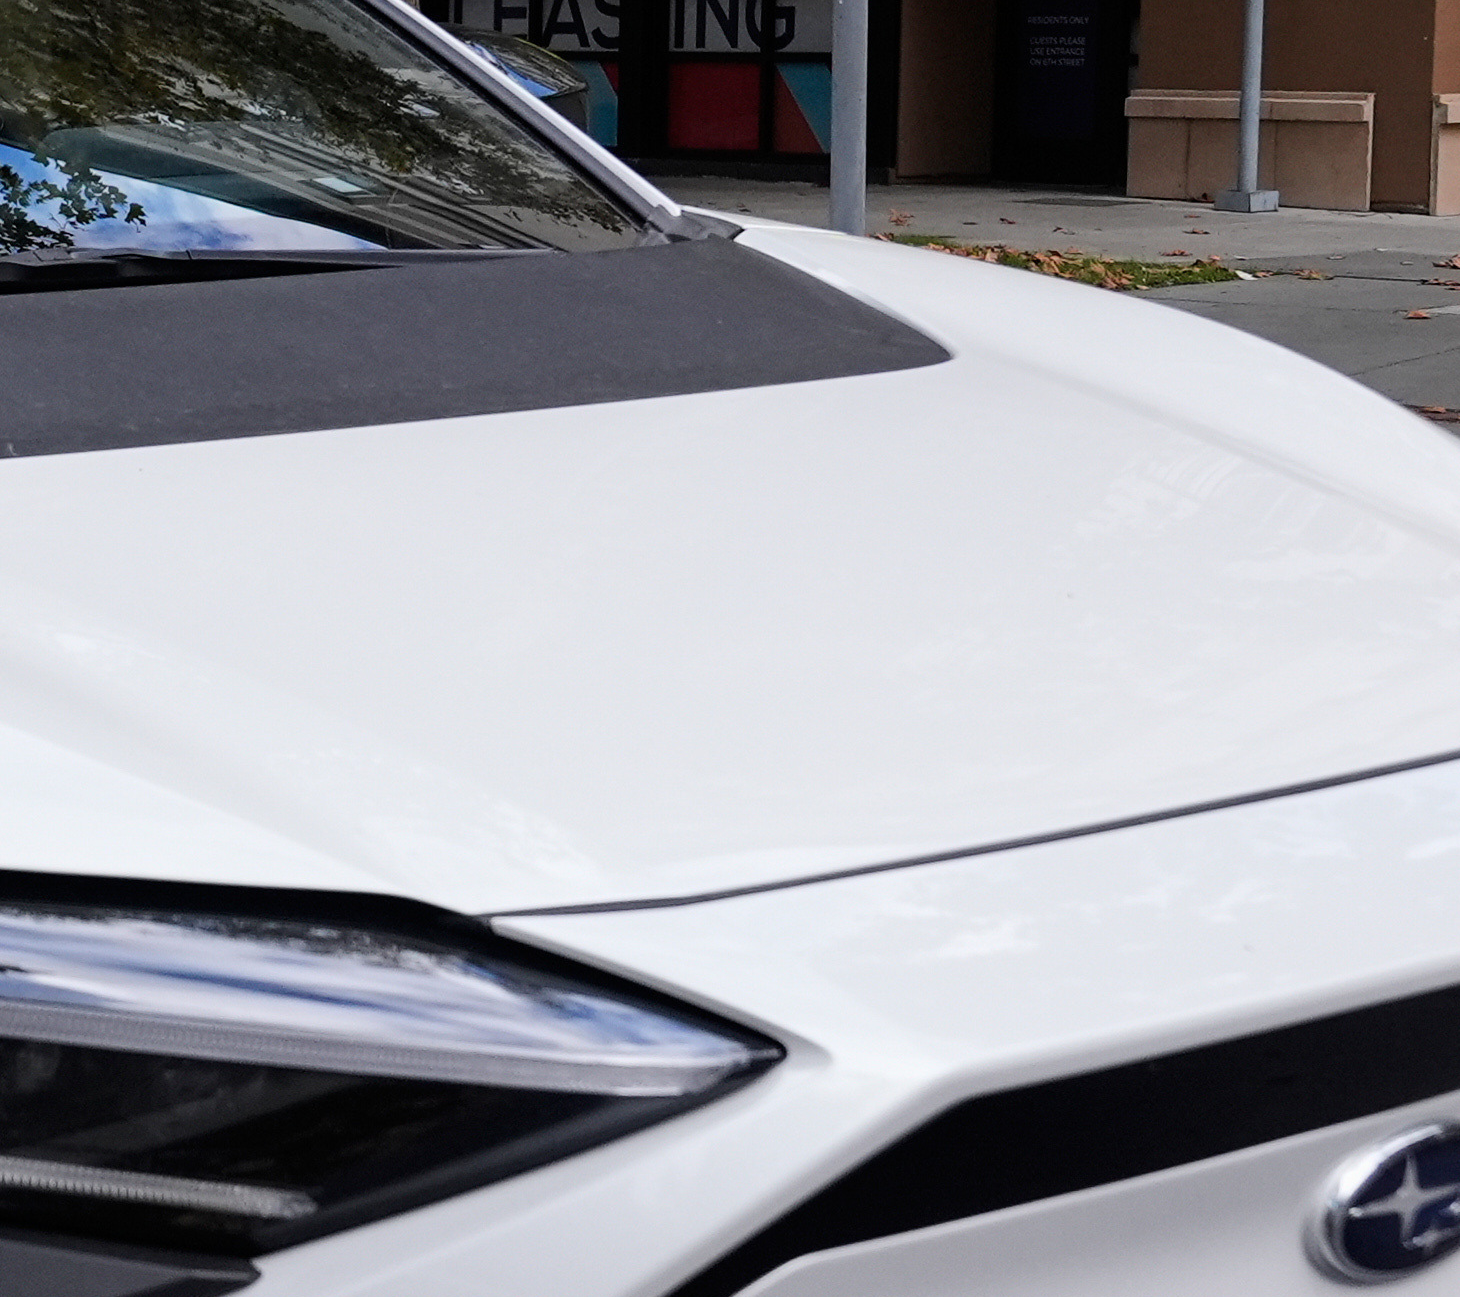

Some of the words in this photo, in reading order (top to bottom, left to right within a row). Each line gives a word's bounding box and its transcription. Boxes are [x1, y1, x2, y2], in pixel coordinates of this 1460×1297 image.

[1027, 15, 1068, 24] RESIDENTS
[1069, 15, 1090, 24] ONLY
[1059, 36, 1086, 45] PLEASE
[1029, 47, 1045, 56] USE
[1046, 47, 1085, 56] ENTRANCE
[1058, 57, 1086, 66] STREET
